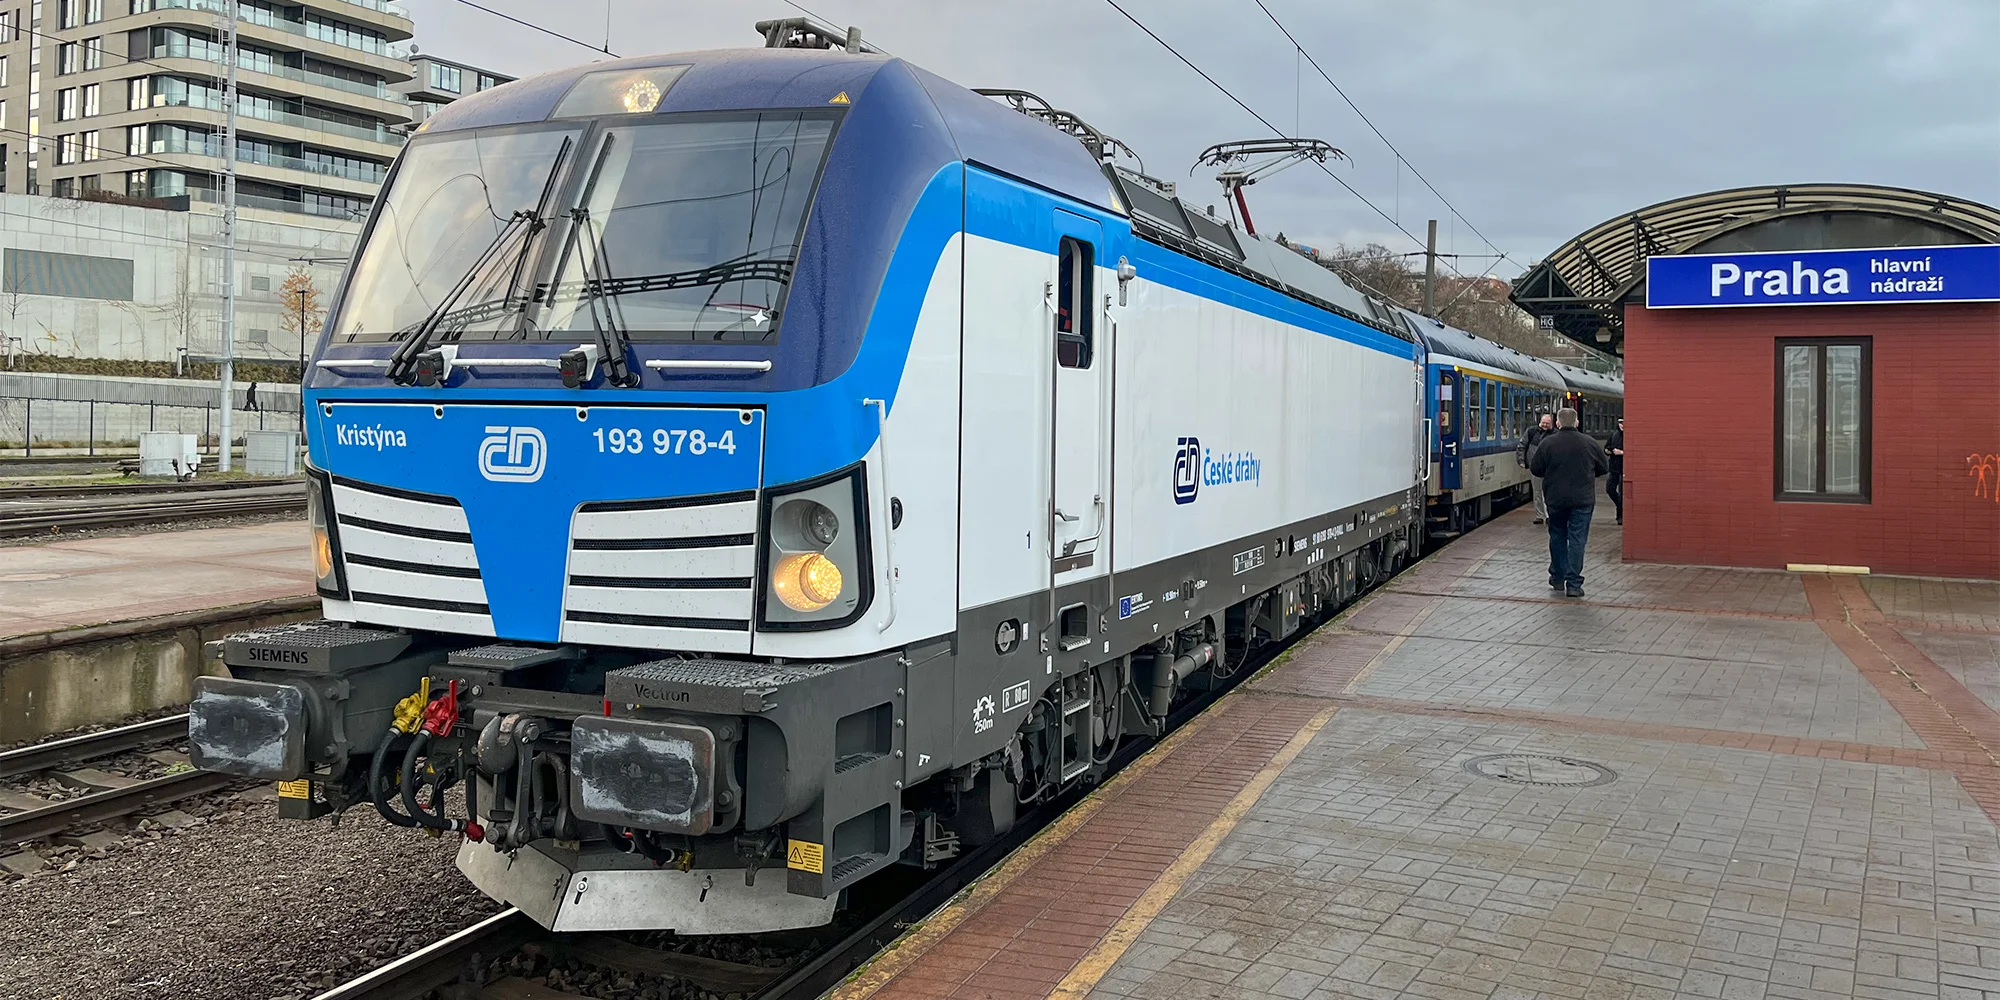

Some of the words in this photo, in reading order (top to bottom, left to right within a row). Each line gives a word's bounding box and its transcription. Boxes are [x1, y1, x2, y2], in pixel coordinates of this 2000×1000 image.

[1870, 257, 1931, 273] hlavní
[1711, 261, 1849, 297] Praha
[1870, 276, 1944, 293] nádraží
[336, 424, 407, 452] Kristýna
[592, 428, 645, 454] 193
[652, 429, 737, 455] 978-4
[1203, 448, 1232, 487] České
[1235, 451, 1261, 487] dráhy
[1026, 530, 1031, 549] 1
[249, 648, 309, 664] SIEMENS
[634, 683, 690, 702] Vectron
[974, 718, 994, 734] 250m
